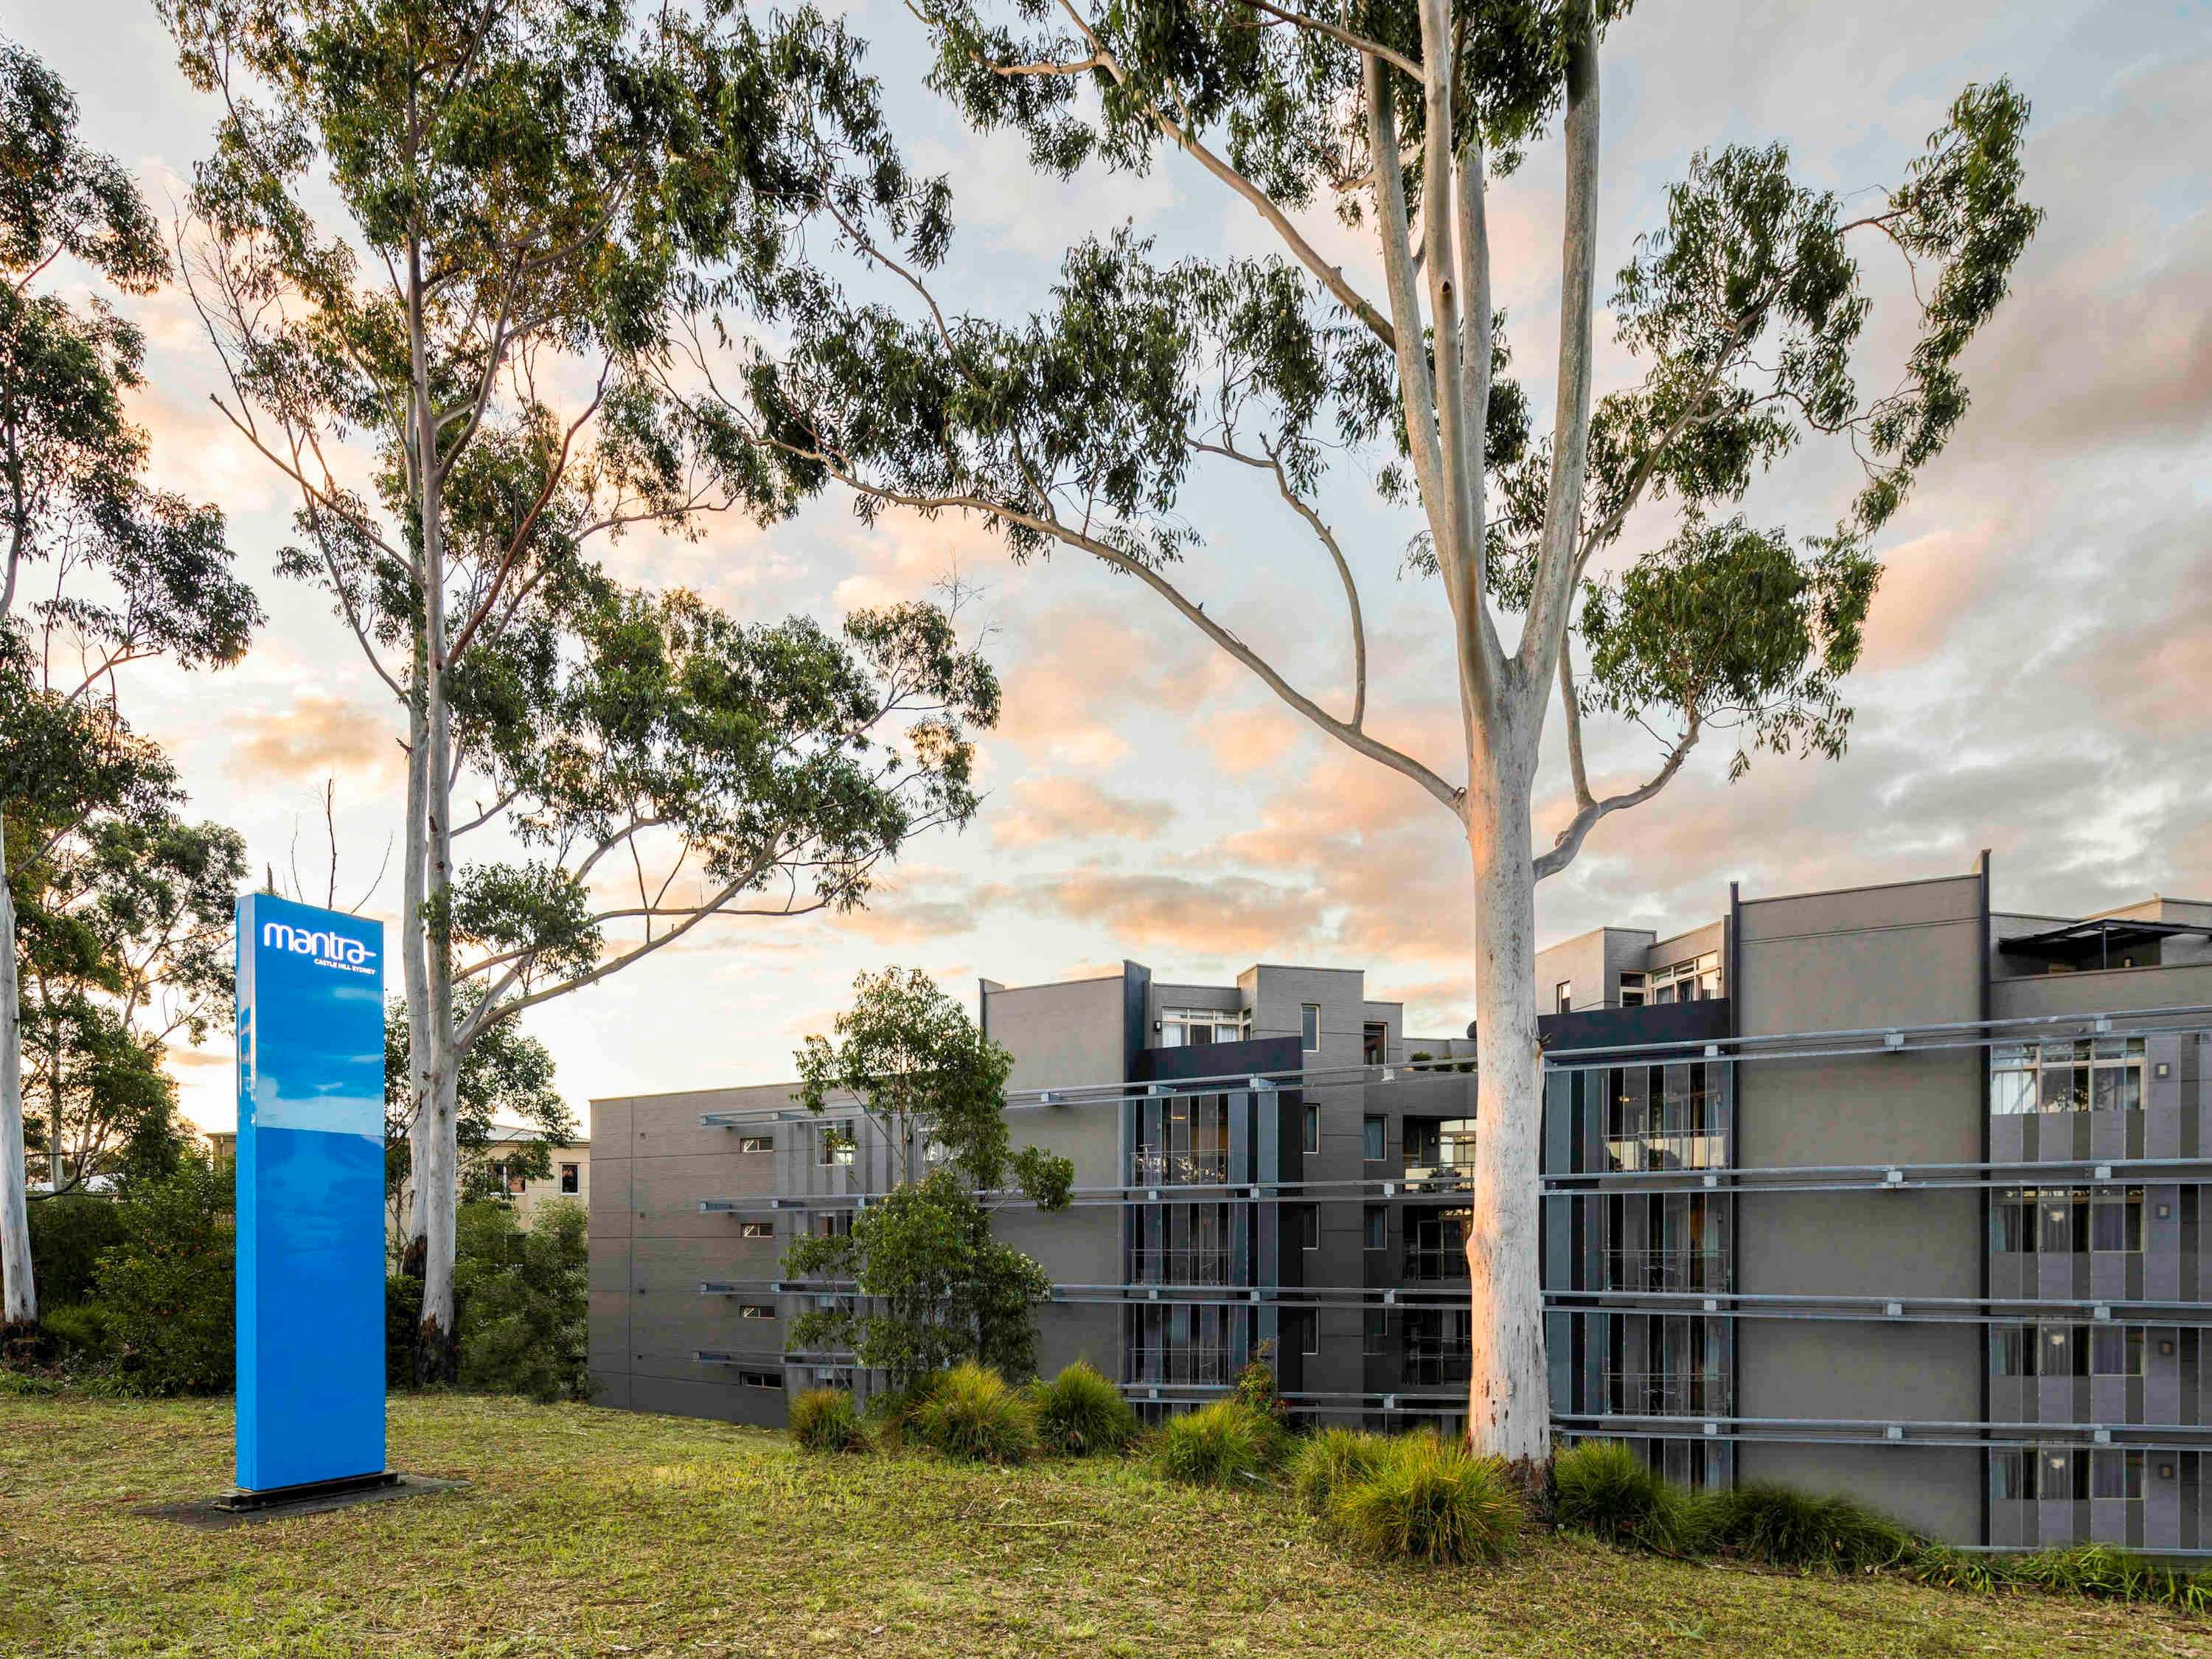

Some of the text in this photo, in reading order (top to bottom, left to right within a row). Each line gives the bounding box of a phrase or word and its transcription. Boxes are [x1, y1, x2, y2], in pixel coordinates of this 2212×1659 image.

[264, 923, 377, 964] mantra
[313, 959, 375, 975] CASTLE HILL SYDNEY
